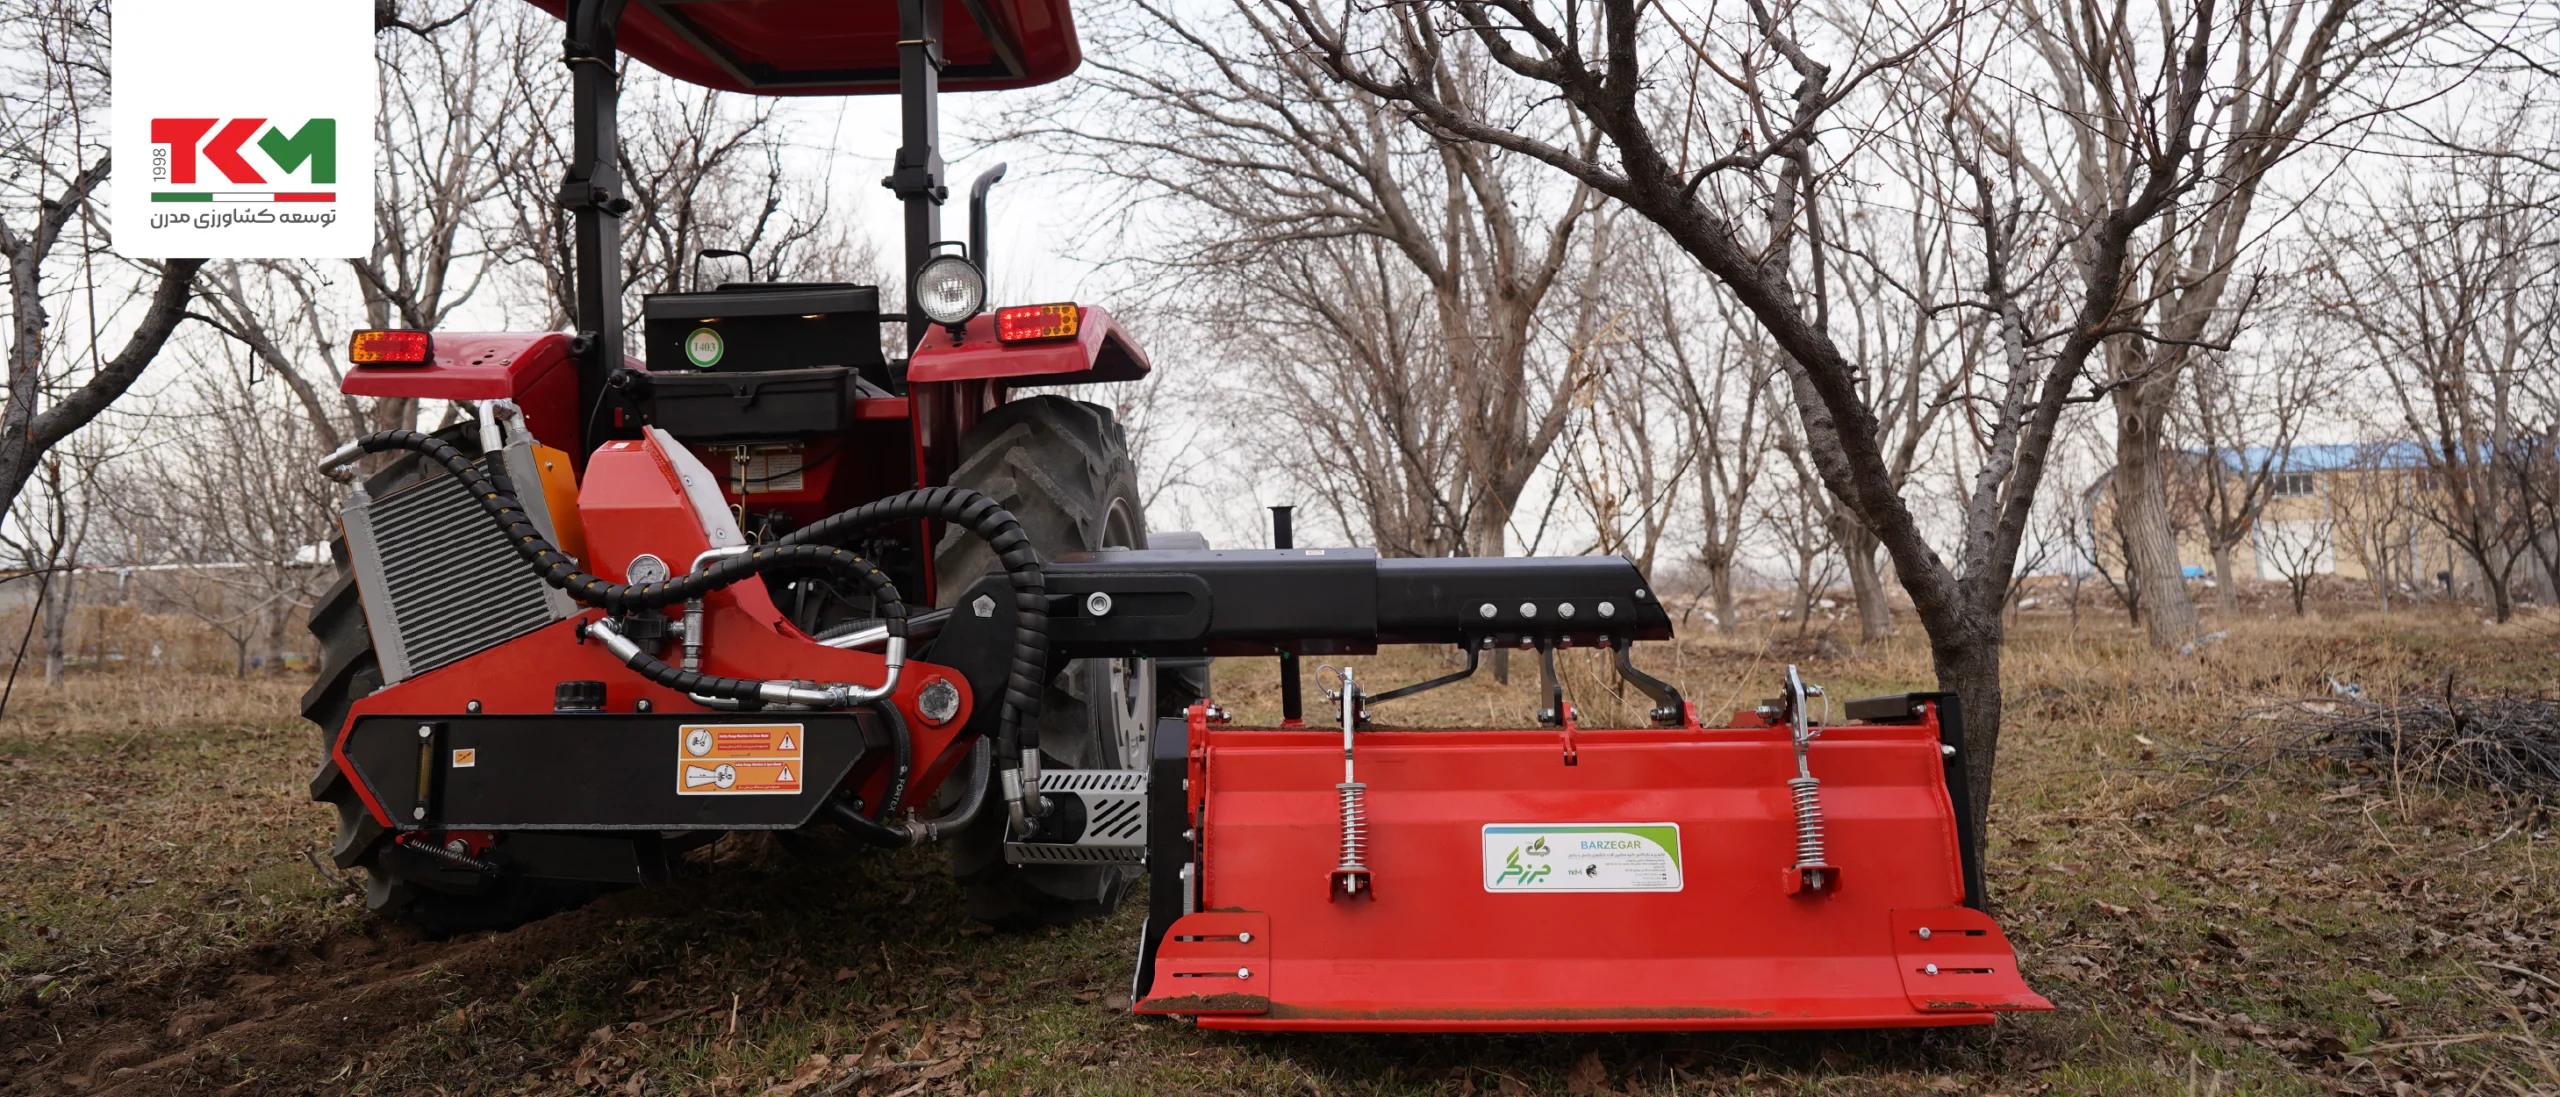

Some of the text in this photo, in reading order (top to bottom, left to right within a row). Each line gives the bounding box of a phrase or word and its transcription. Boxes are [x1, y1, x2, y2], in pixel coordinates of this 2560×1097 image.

[694, 342, 716, 352] 1403
[888, 778, 905, 812] FORTEX
[1580, 840, 1641, 850] BARZEGAR
